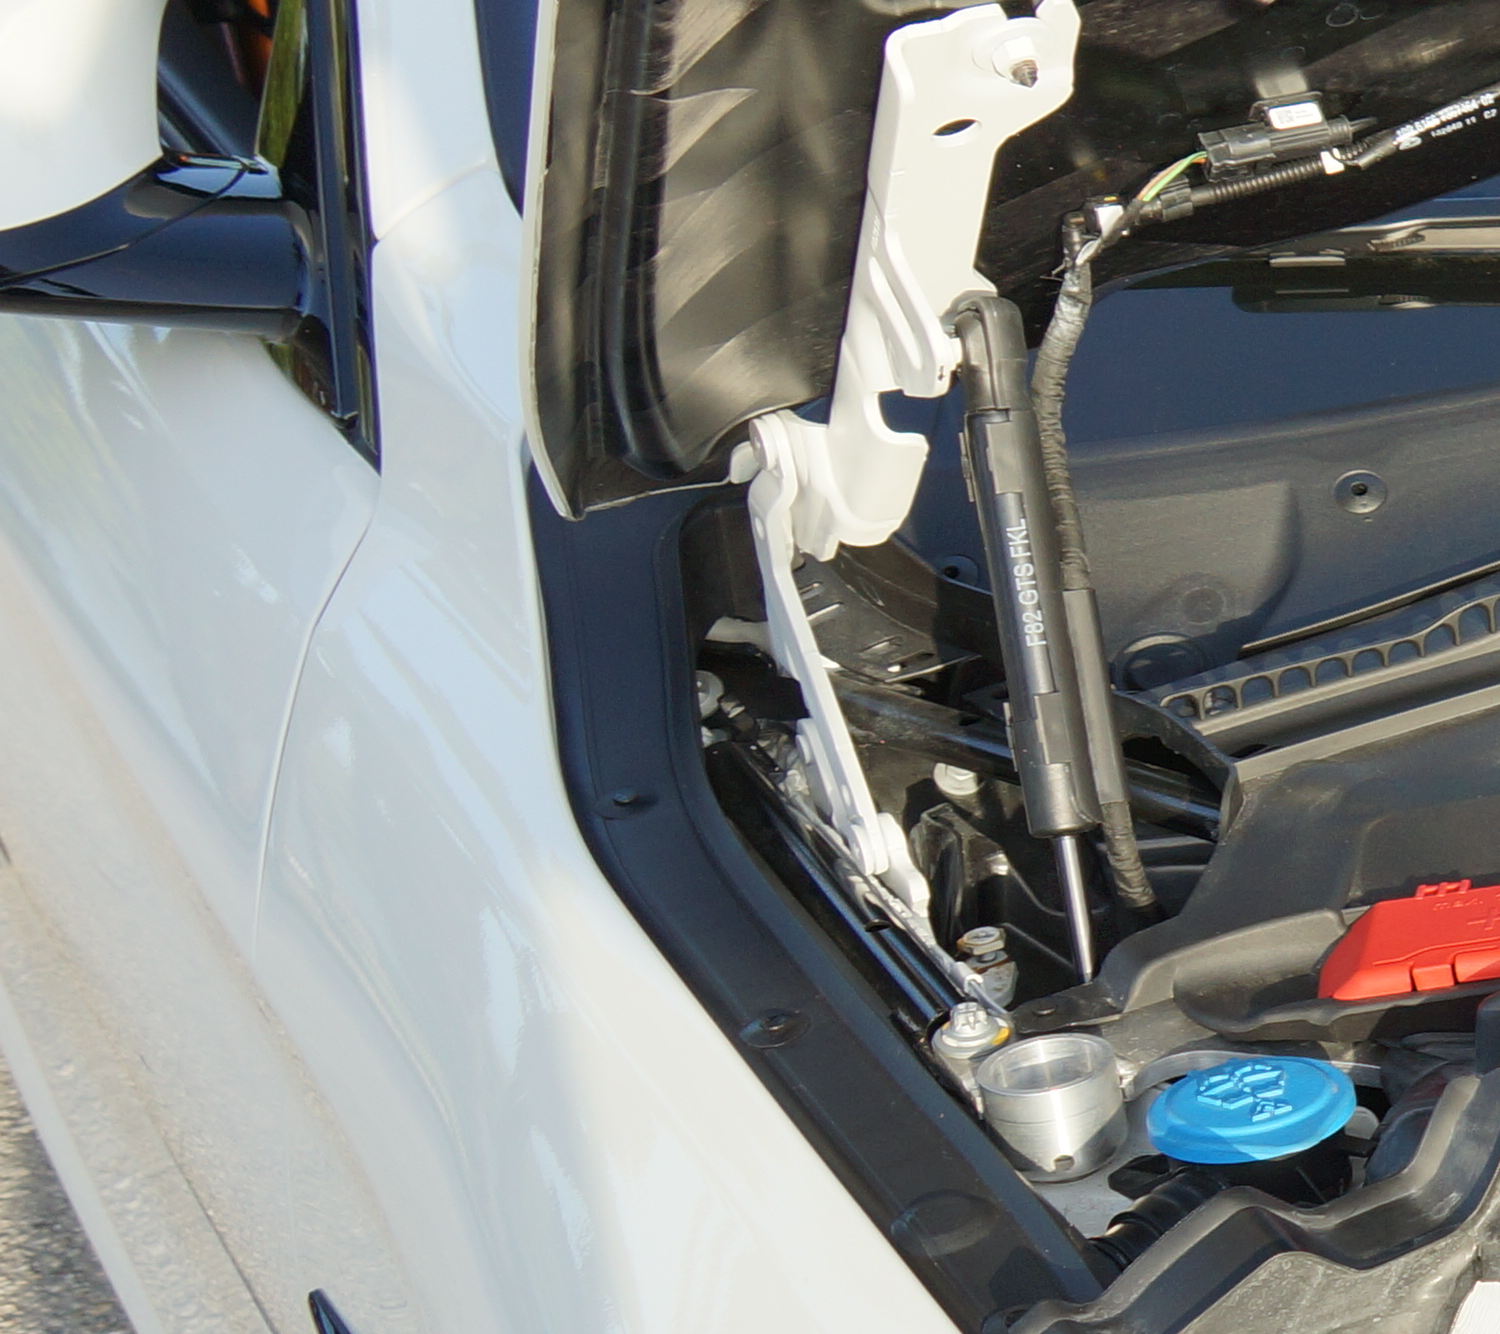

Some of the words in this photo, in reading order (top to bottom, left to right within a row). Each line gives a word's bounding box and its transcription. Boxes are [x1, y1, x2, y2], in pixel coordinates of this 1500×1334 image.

[1006, 518, 1032, 558] FKL
[1013, 563, 1039, 605] GTS
[1022, 610, 1047, 647] F82
